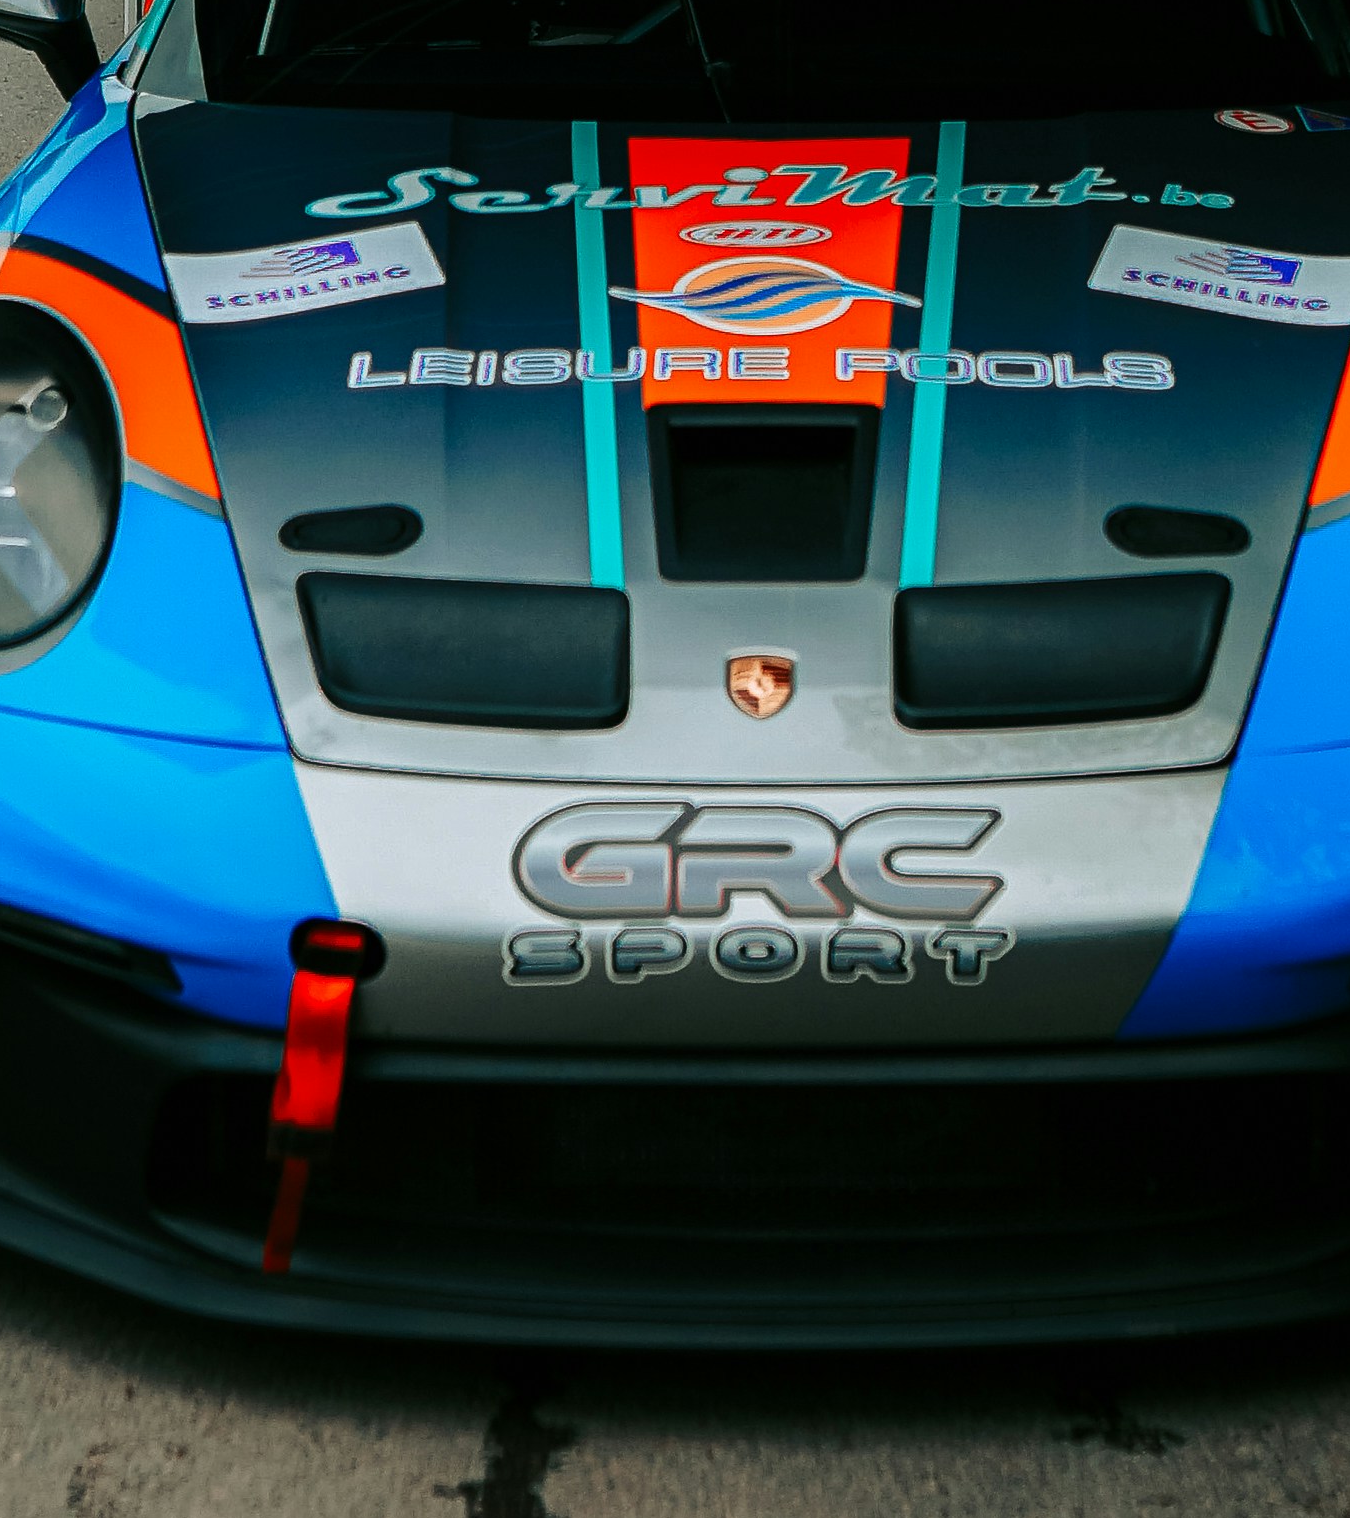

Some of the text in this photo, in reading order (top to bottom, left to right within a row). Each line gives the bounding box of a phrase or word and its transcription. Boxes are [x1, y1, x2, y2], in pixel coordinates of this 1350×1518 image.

[204, 265, 412, 310] SCHILLING
[1121, 266, 1332, 312] SCHILLING
[348, 347, 1176, 390] LEISURE POOLS
[511, 799, 1004, 921] GRC
[501, 924, 1015, 986] SPORT
